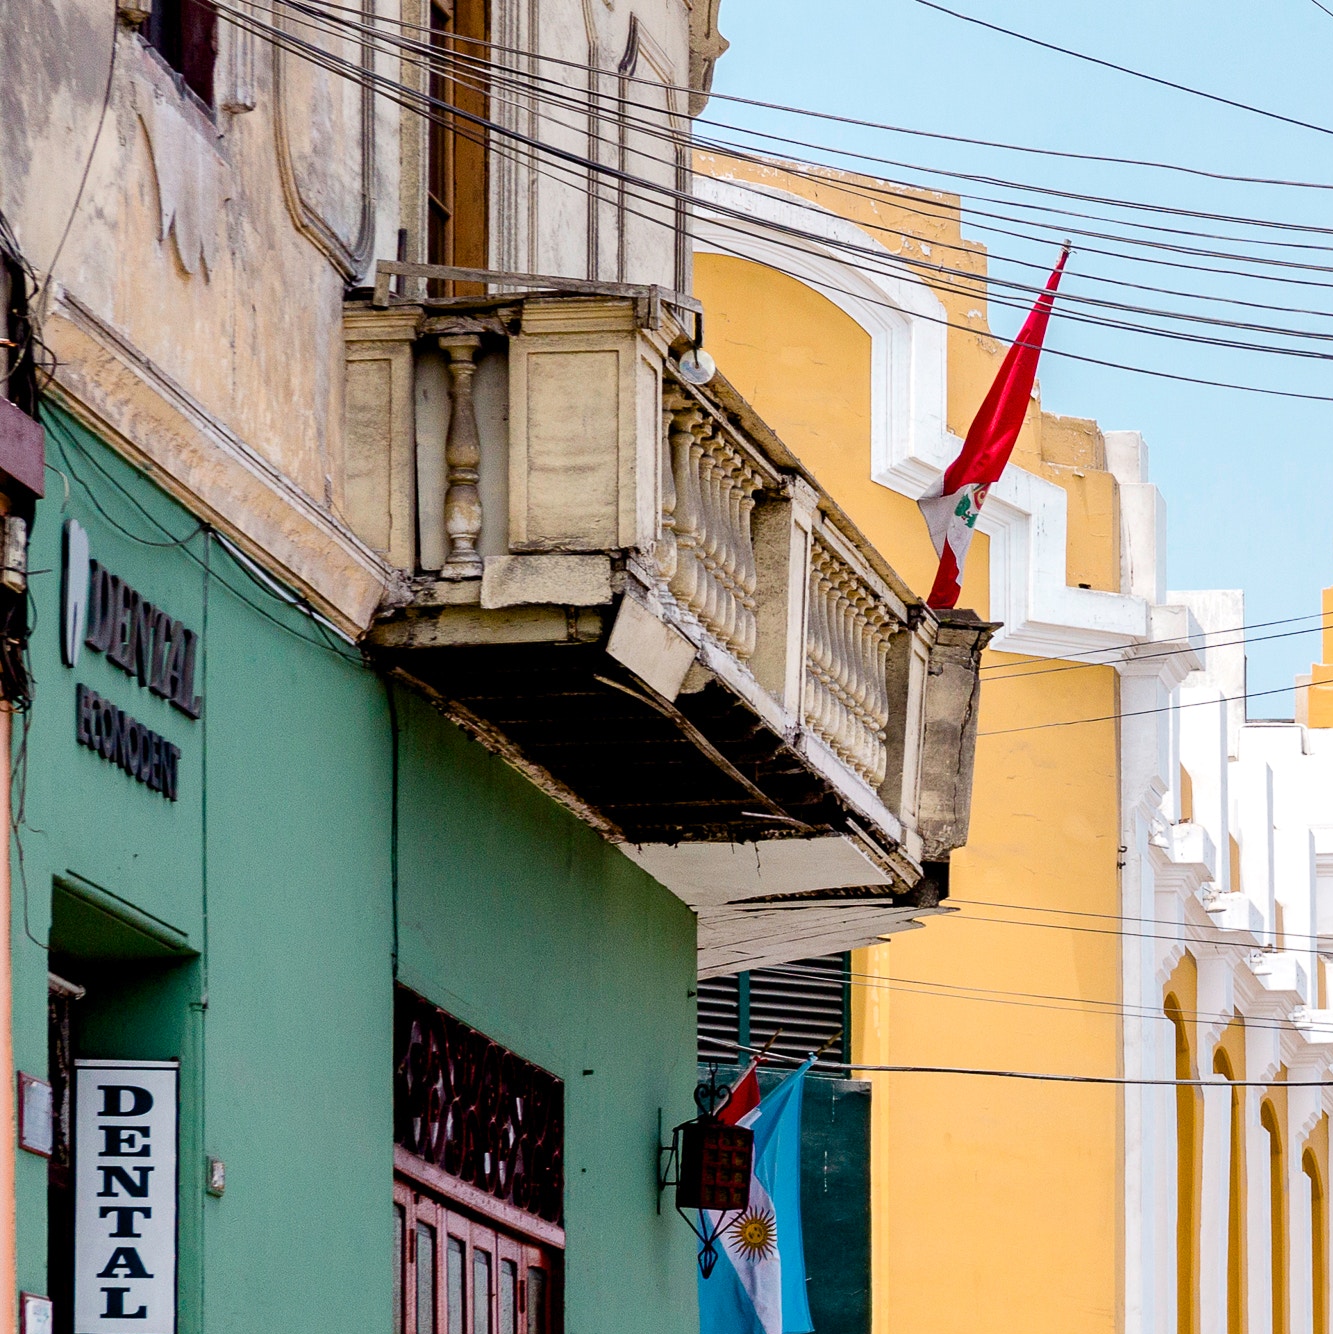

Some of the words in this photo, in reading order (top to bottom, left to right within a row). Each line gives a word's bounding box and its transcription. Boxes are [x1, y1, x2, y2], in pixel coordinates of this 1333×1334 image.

[85, 558, 203, 719] DENTAL
[76, 683, 181, 802] ECONODENT
[97, 1085, 155, 1319] DENTAL
